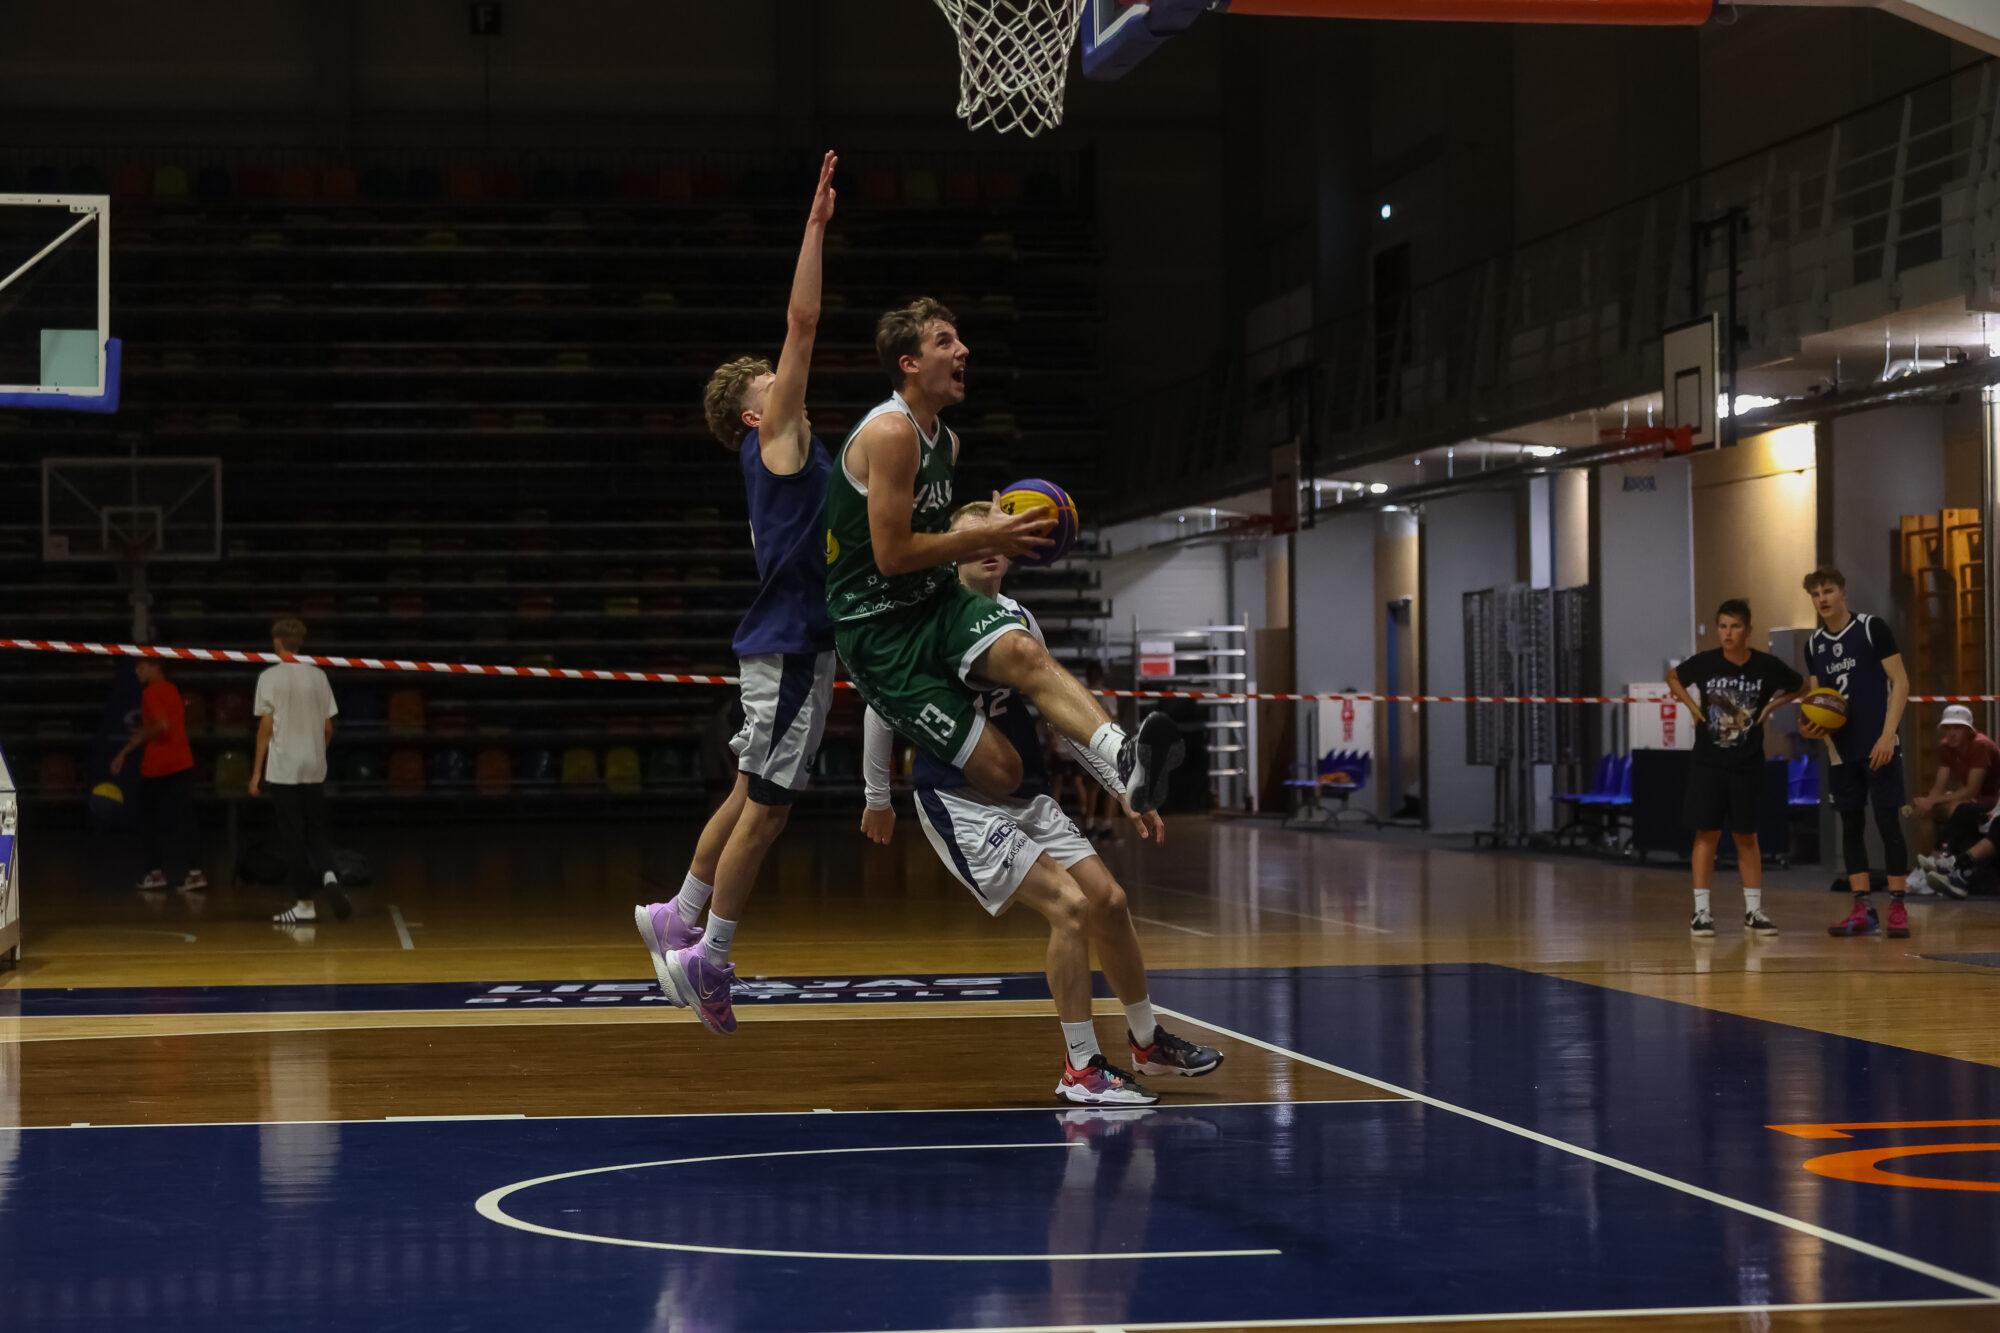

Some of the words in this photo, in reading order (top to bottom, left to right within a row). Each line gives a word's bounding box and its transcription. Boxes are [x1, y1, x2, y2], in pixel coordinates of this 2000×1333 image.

[1835, 672, 1850, 700] 2
[914, 702, 958, 747] 13
[464, 989, 1000, 1004] BASKTBOLS
